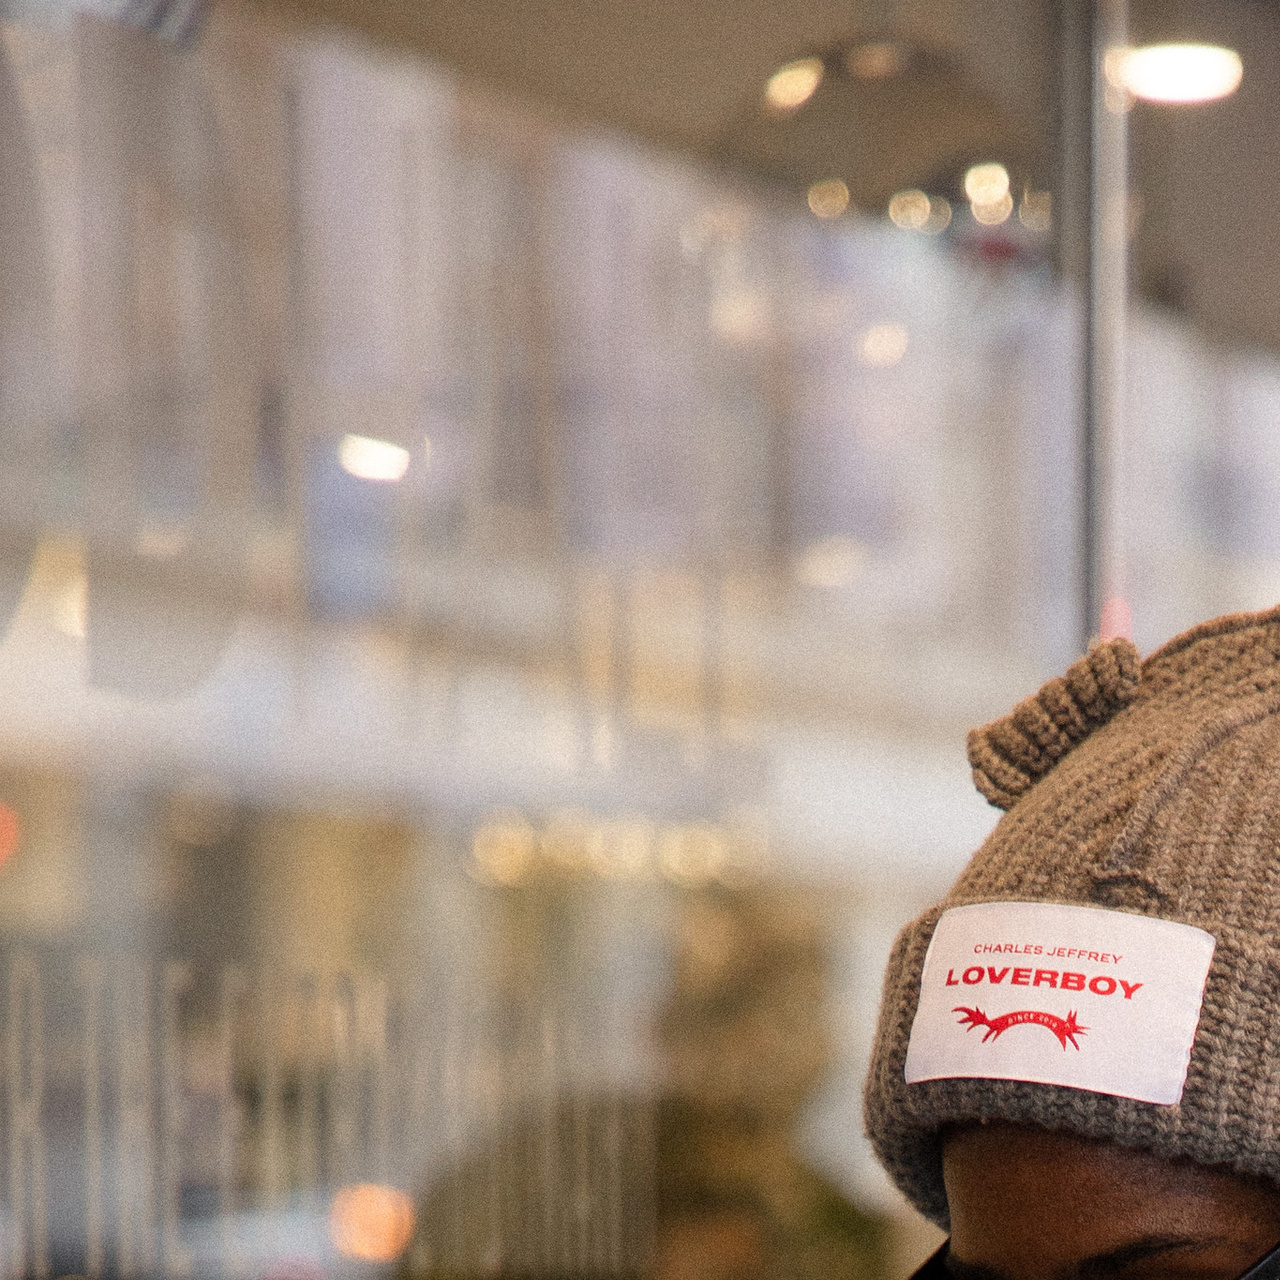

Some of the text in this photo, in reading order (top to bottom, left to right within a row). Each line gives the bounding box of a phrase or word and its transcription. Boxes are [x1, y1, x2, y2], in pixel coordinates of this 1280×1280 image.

[973, 943, 1123, 965] CHARLES JEFFREY
[945, 965, 1144, 1000] LOVERBOY
